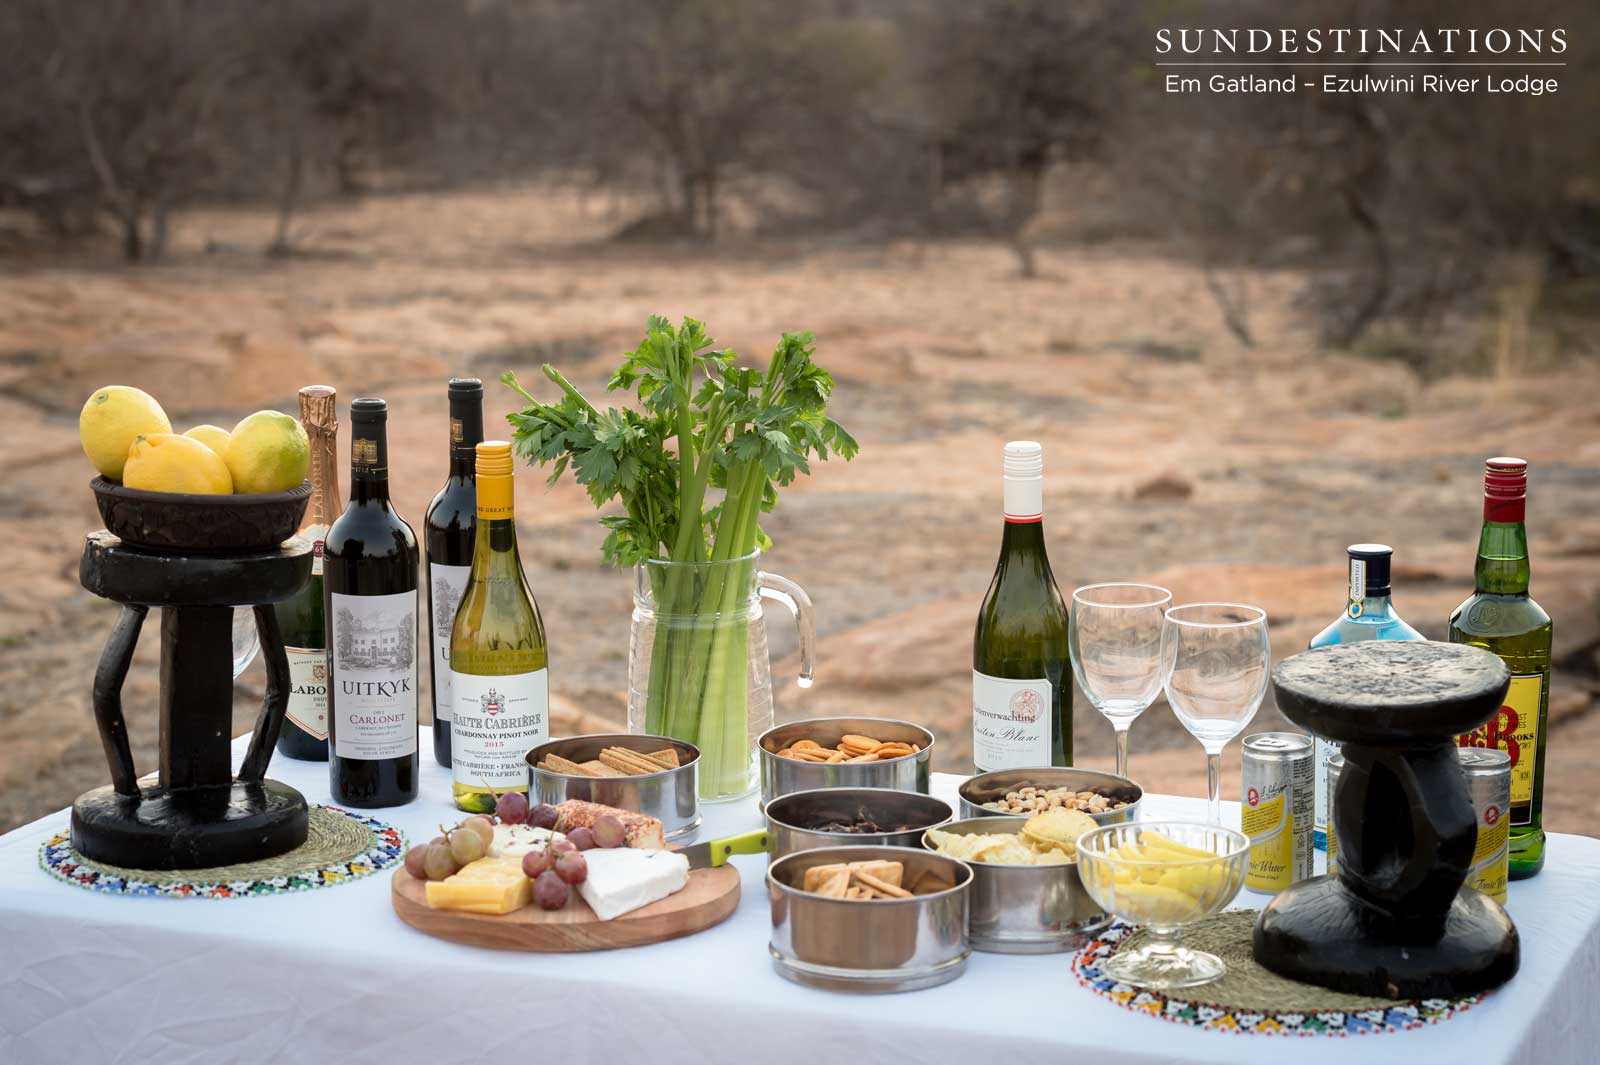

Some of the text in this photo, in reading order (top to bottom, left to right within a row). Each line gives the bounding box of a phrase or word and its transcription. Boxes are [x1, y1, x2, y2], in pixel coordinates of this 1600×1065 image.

[290, 682, 326, 695] LABO
[343, 678, 411, 697] UITKYK
[453, 712, 541, 730] HAUTE CABRIÈRE
[454, 728, 540, 740] CHARDONNAY PINOT NOIR
